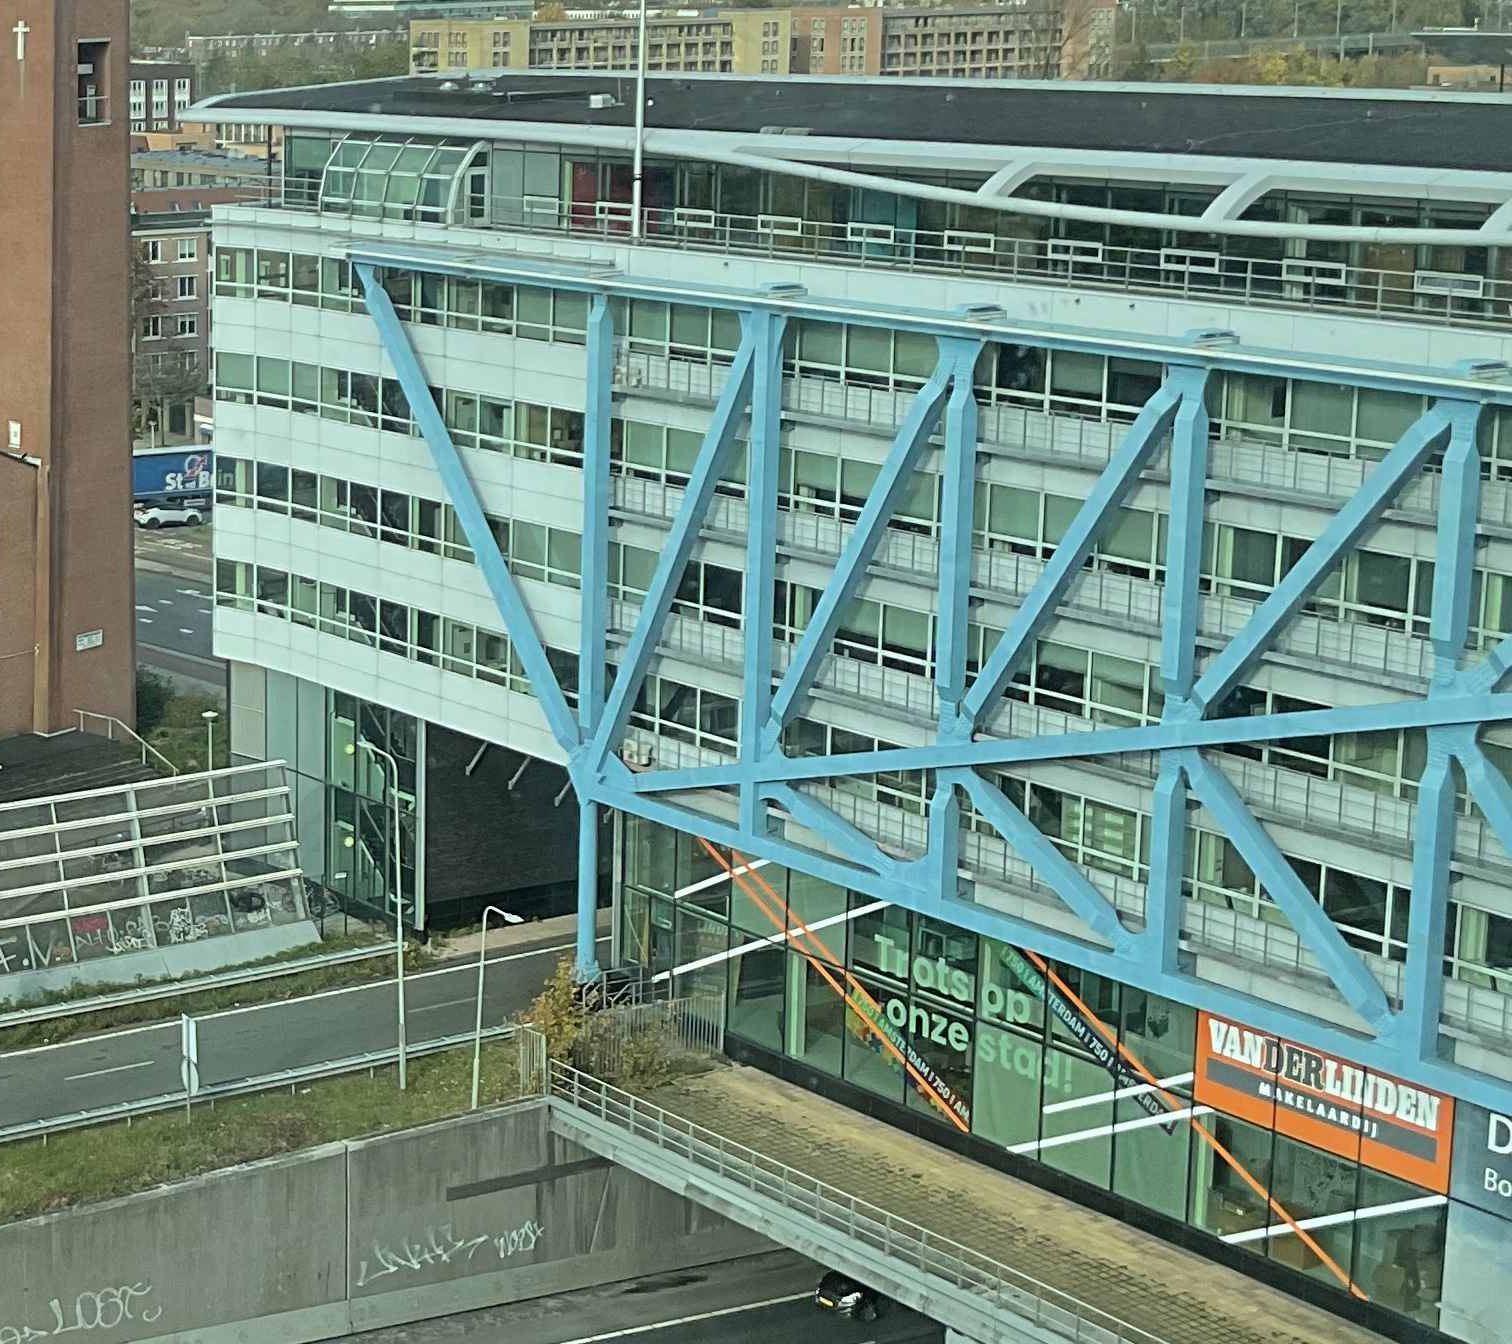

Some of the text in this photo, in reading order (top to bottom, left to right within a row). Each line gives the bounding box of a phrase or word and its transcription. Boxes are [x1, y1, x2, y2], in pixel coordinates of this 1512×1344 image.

[874, 934, 969, 1001] Trots
[886, 998, 969, 1052] onze
[1089, 1037, 1109, 1060] 750
[932, 1075, 951, 1099] 750
[1258, 1081, 1378, 1139] MAKELAARDIJ
